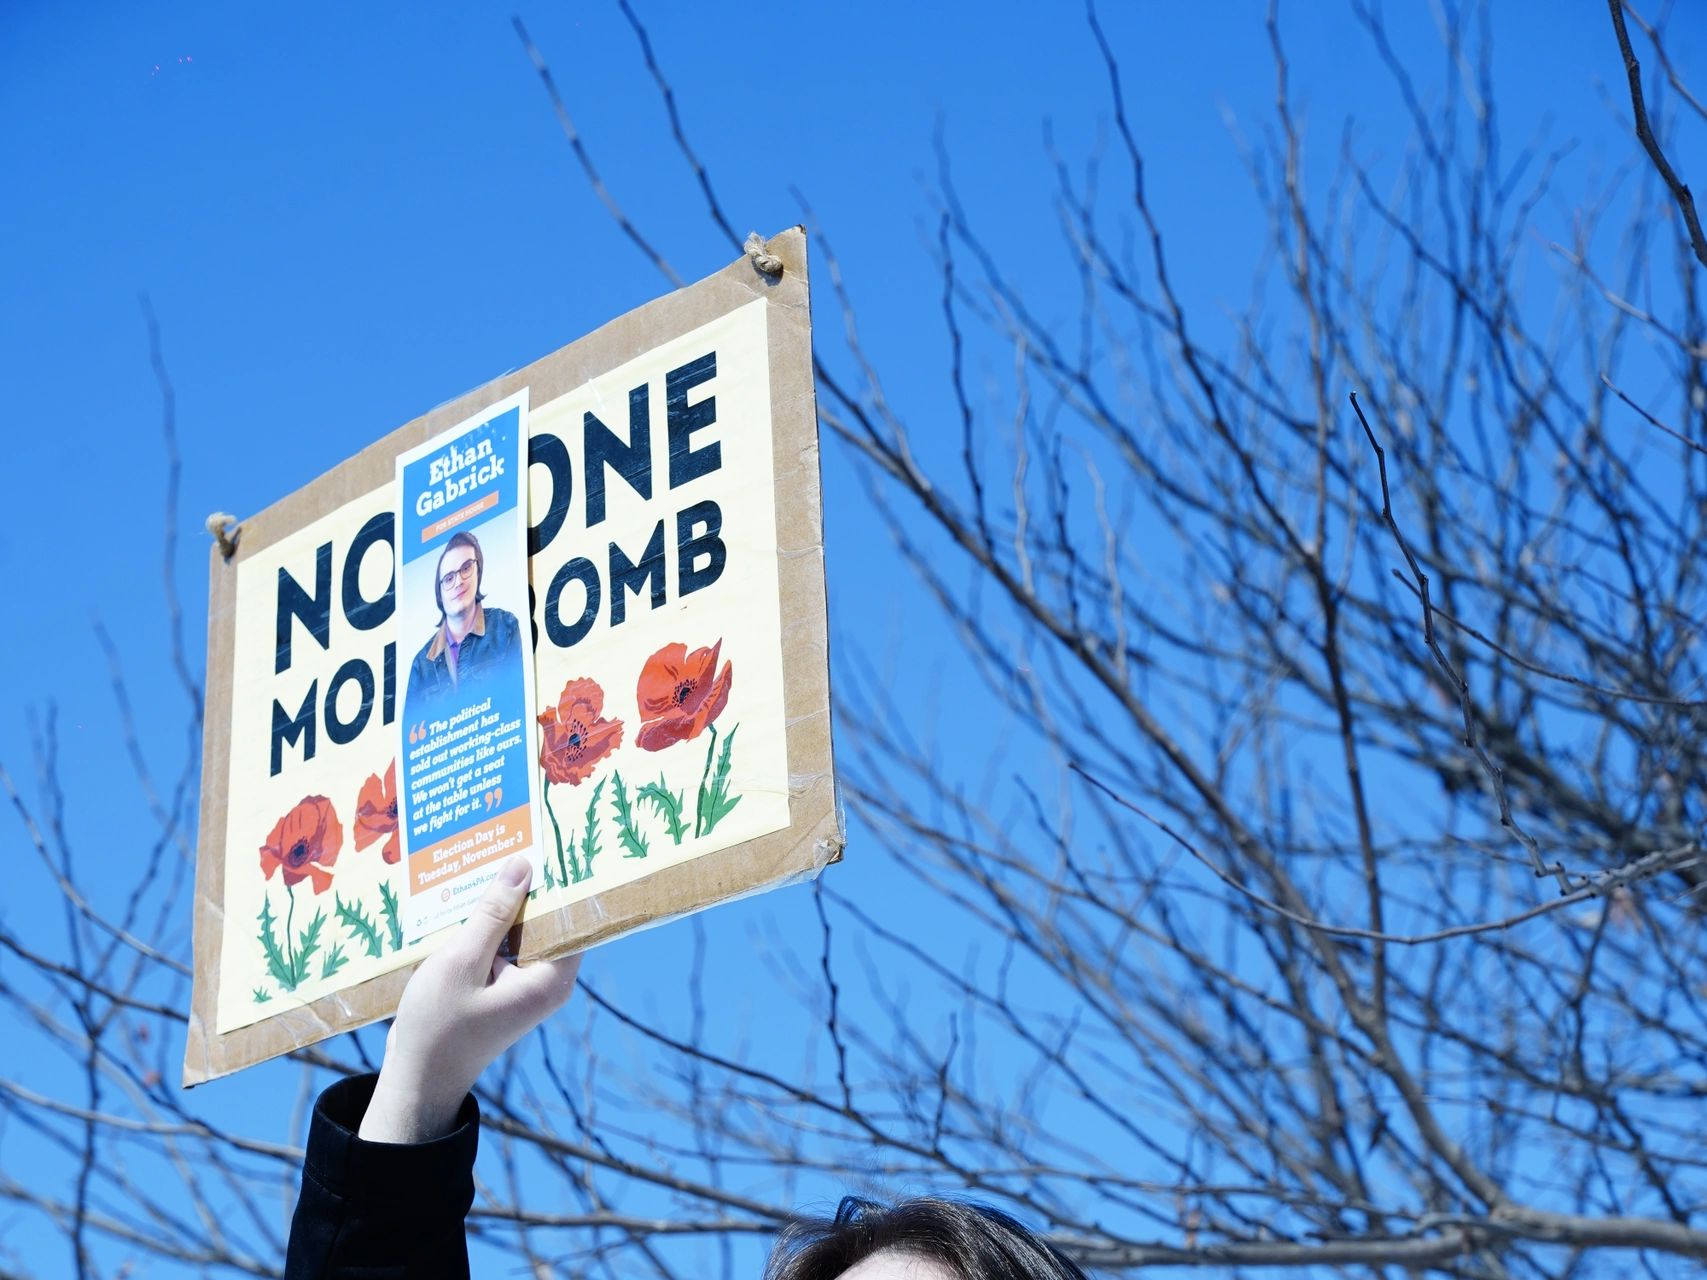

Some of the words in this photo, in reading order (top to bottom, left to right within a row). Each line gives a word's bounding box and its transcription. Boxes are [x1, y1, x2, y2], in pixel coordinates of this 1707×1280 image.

[416, 455, 505, 517] Gabrick
[429, 438, 493, 486] Ethan
[528, 500, 727, 655] OMB
[409, 719, 480, 760] establishment
[480, 712, 500, 728] has
[429, 720, 448, 736] The
[449, 697, 492, 729] political
[410, 756, 431, 775] sold
[432, 749, 449, 765] out
[449, 719, 521, 757] working-class
[411, 754, 475, 790] communities
[475, 746, 496, 761] like
[496, 734, 522, 752] ours.
[412, 790, 428, 805] We
[456, 769, 473, 789] get
[474, 767, 482, 777] a
[483, 755, 505, 773] seat
[413, 807, 424, 821] at
[425, 800, 442, 815] the
[443, 788, 469, 807] table
[469, 774, 502, 795] unless
[413, 825, 429, 836] we
[429, 809, 453, 833] fight
[454, 804, 470, 821] for
[471, 797, 482, 811] it.
[418, 860, 462, 885] Tuesday,
[462, 837, 516, 866] November
[516, 830, 523, 844] 3
[433, 838, 474, 864] Election
[475, 829, 494, 846] Day
[496, 824, 506, 836] is
